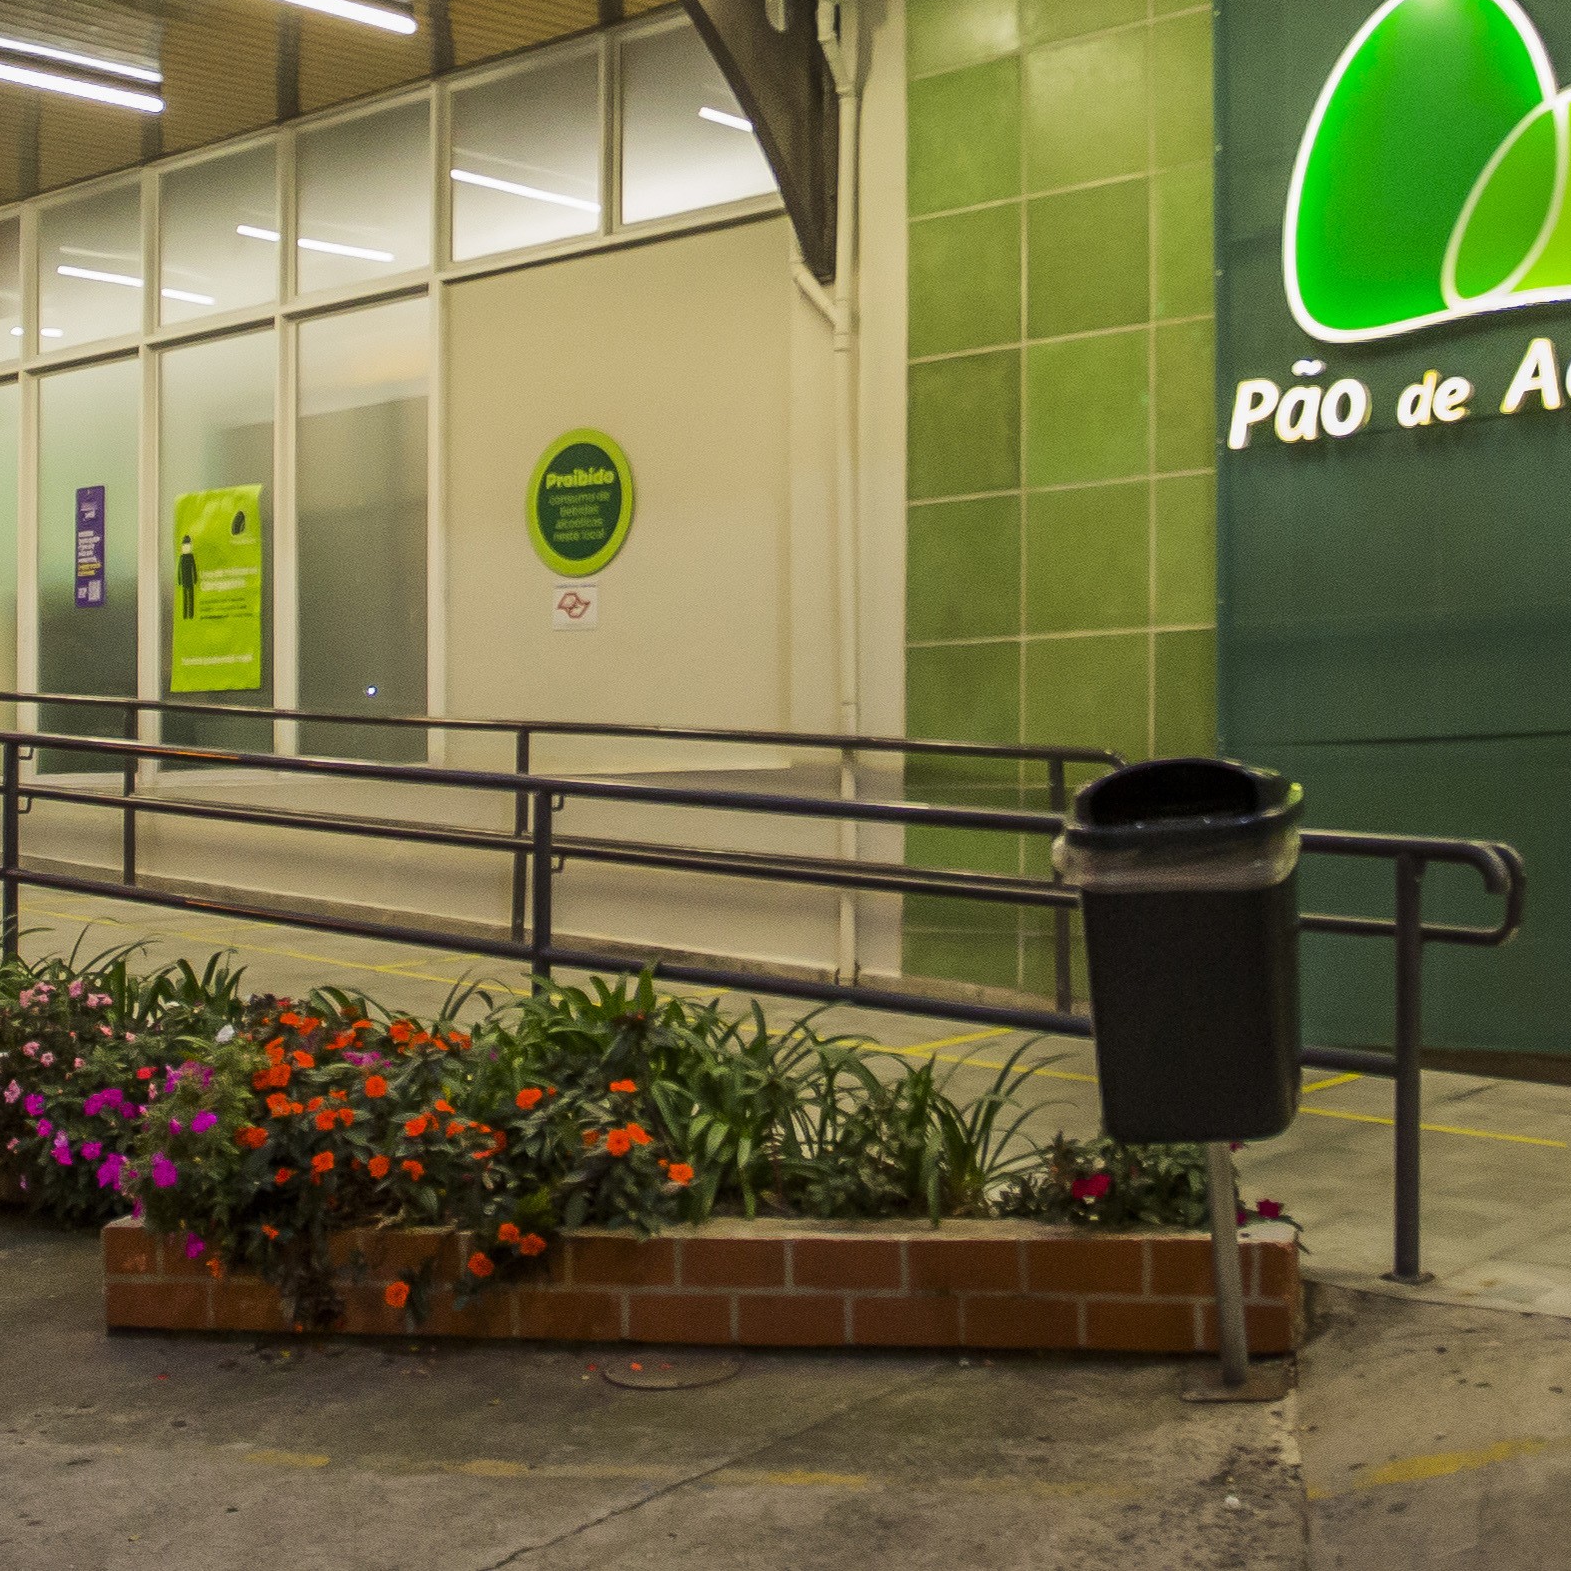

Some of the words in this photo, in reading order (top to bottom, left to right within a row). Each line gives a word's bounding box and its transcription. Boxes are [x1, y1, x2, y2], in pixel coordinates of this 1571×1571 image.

[1228, 359, 1371, 449] Pão
[1396, 370, 1472, 428] de
[546, 467, 614, 489] Proibido
